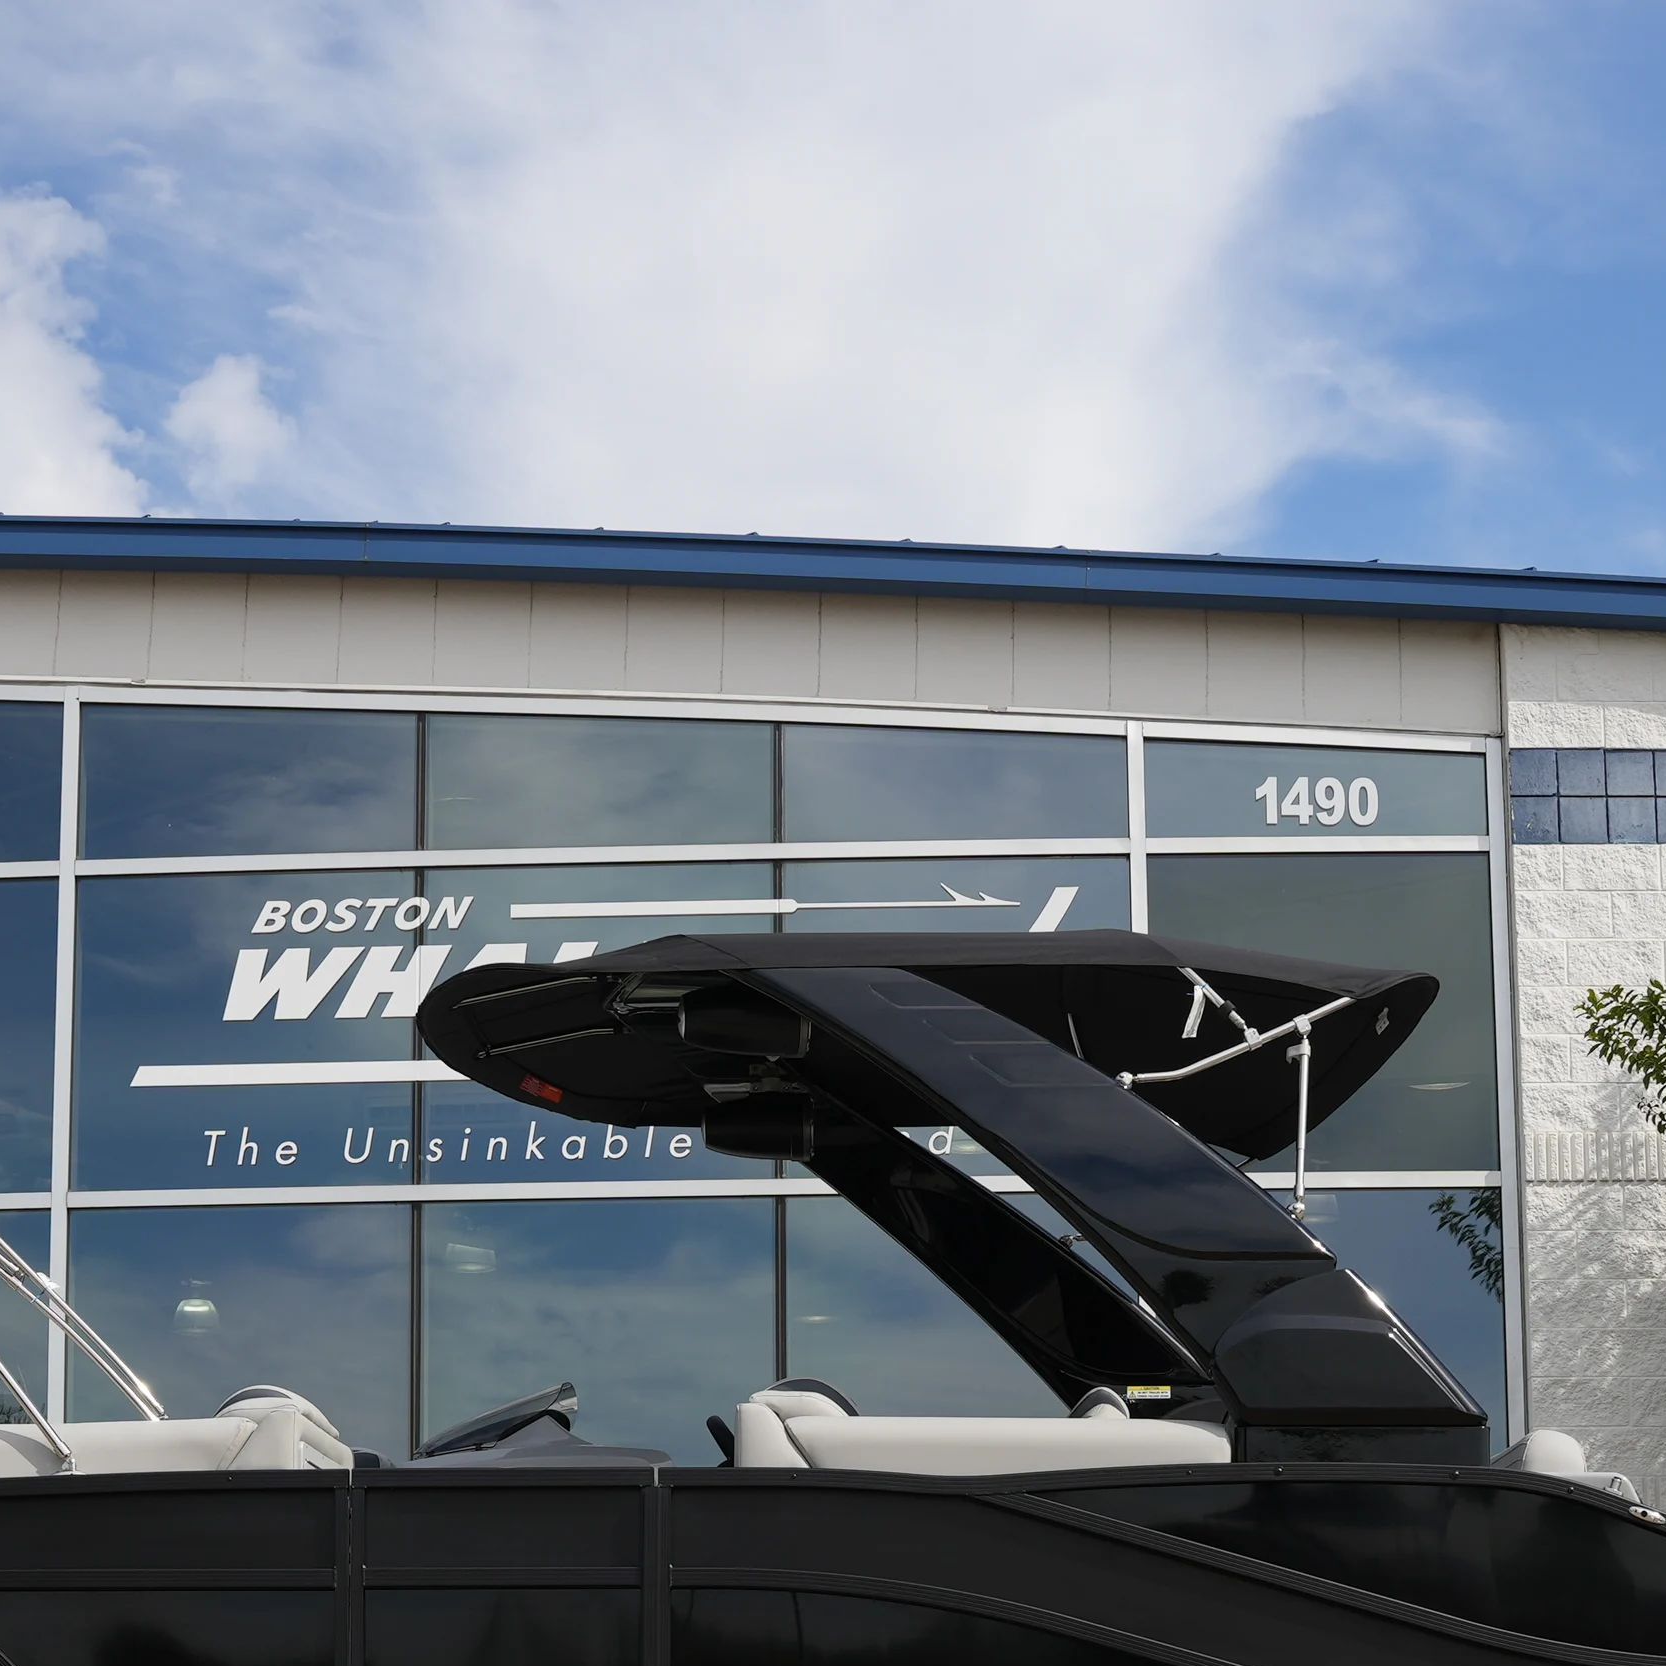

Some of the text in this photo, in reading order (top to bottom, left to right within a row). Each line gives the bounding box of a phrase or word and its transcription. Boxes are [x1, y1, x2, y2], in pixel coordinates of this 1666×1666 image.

[1255, 776, 1380, 826] 1490
[251, 896, 475, 935] BOSTON
[222, 941, 599, 1021] WH
[203, 1121, 693, 1166] The Unsinkable
